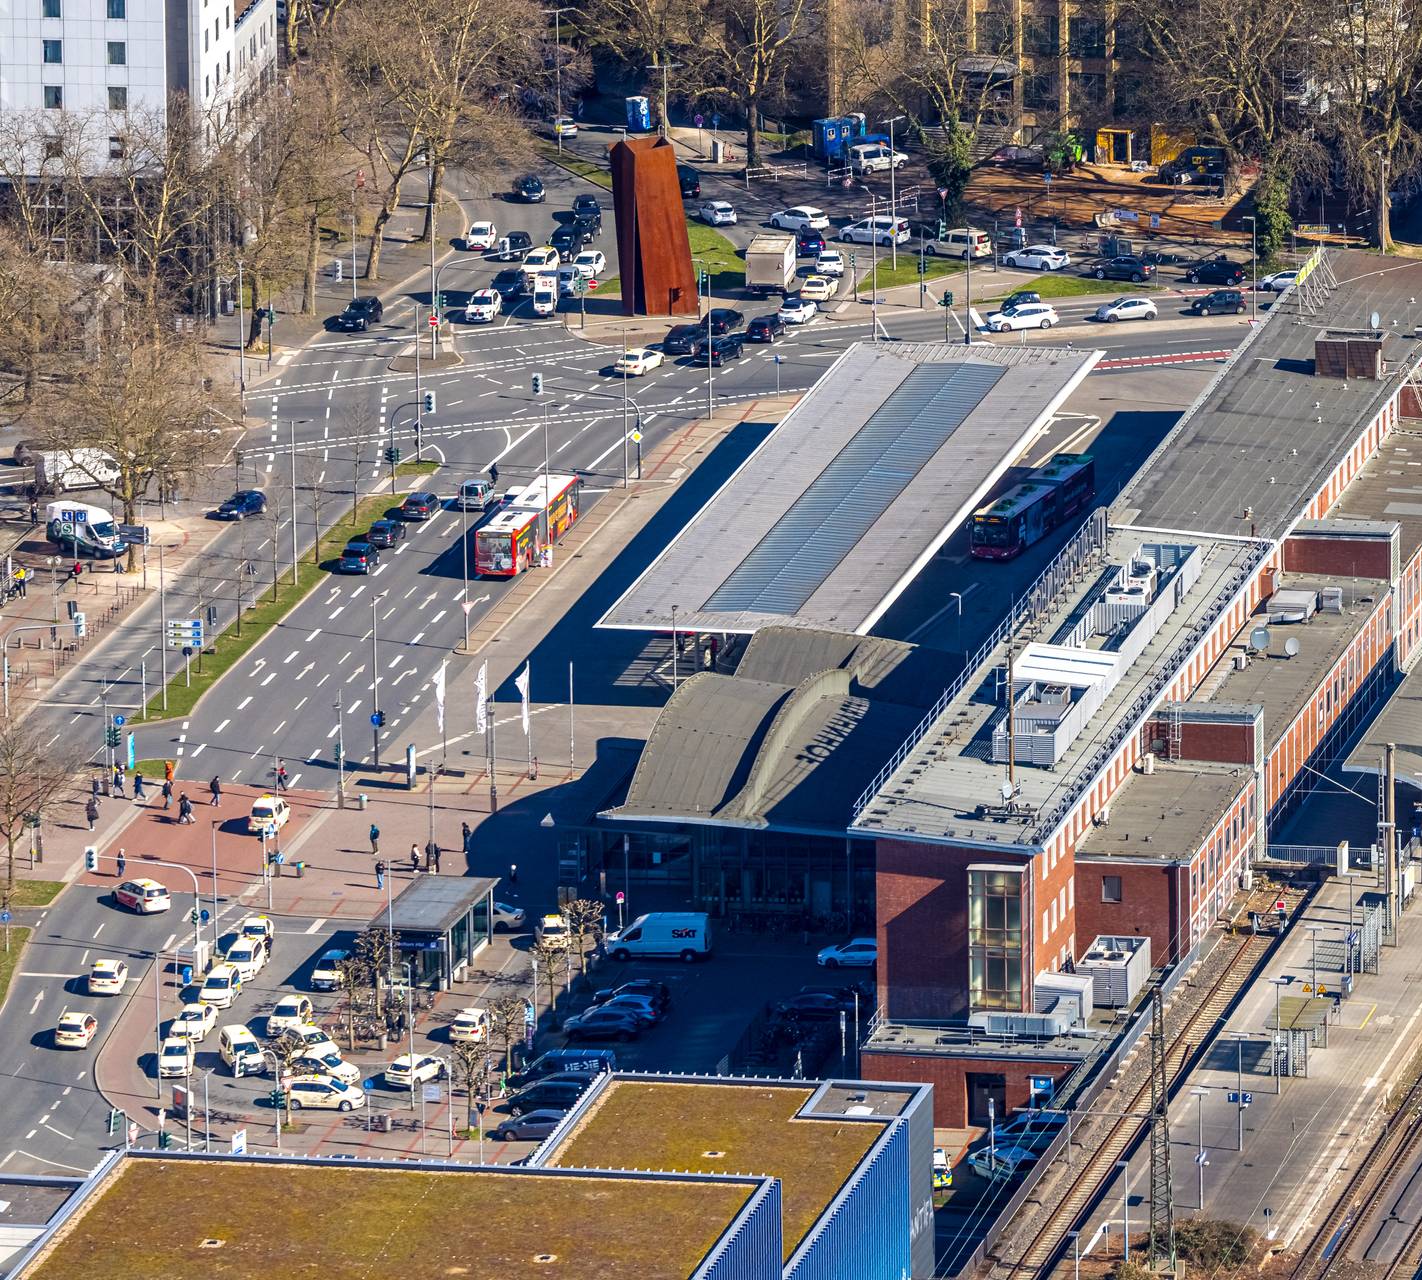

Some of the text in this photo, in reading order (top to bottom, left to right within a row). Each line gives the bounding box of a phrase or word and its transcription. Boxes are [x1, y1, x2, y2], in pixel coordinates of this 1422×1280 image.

[62, 523, 72, 533] S
[671, 928, 697, 939] SIXT
[1245, 1093, 1251, 1102] 2
